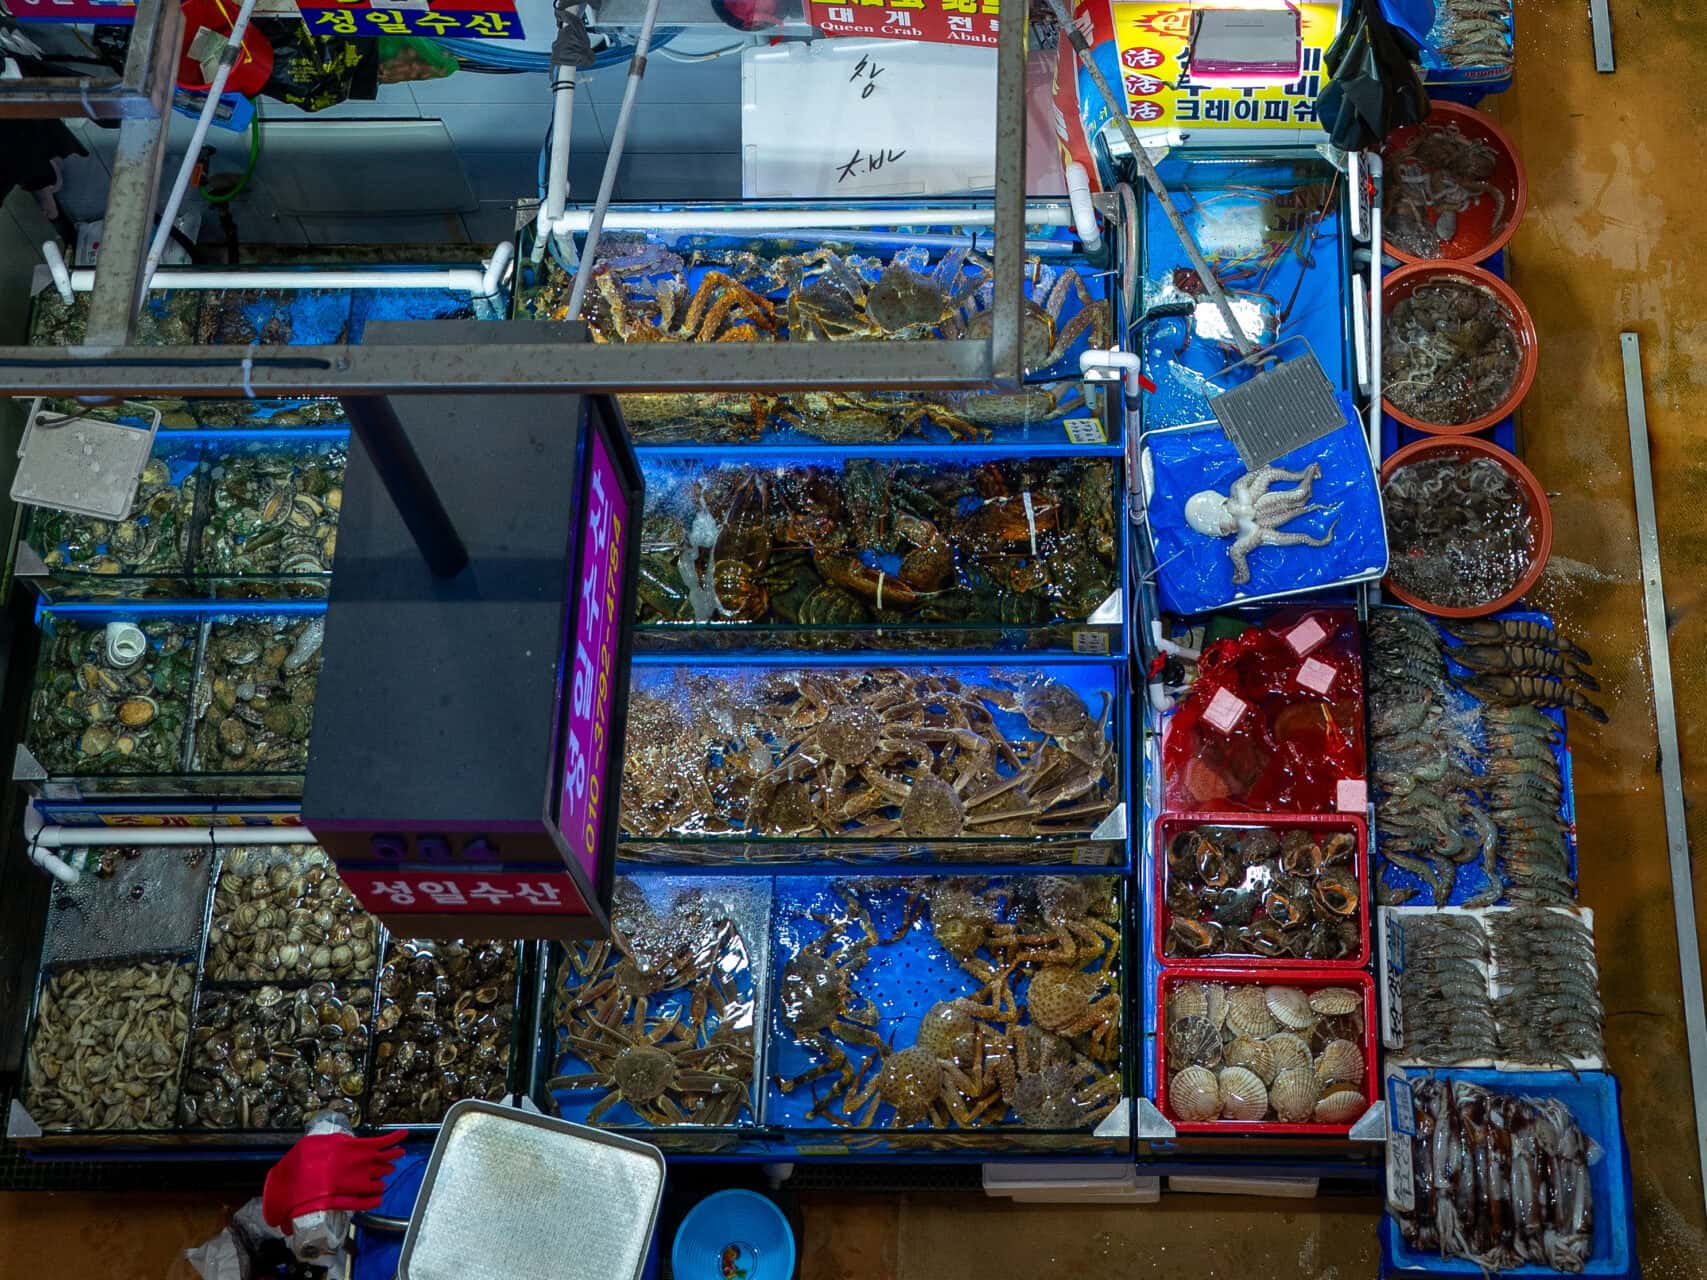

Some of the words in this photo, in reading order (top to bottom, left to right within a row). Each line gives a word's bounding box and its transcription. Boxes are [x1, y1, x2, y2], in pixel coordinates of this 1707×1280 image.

[315, 9, 512, 37] 성일수산
[820, 21, 875, 34] Queen
[881, 25, 923, 37] Crab
[947, 31, 999, 44] Abalo
[1175, 98, 1319, 122] 크레이피쉬
[565, 468, 609, 817] 성일수산
[585, 512, 622, 854] 010-3792-4784
[371, 880, 562, 906] 성일수산
